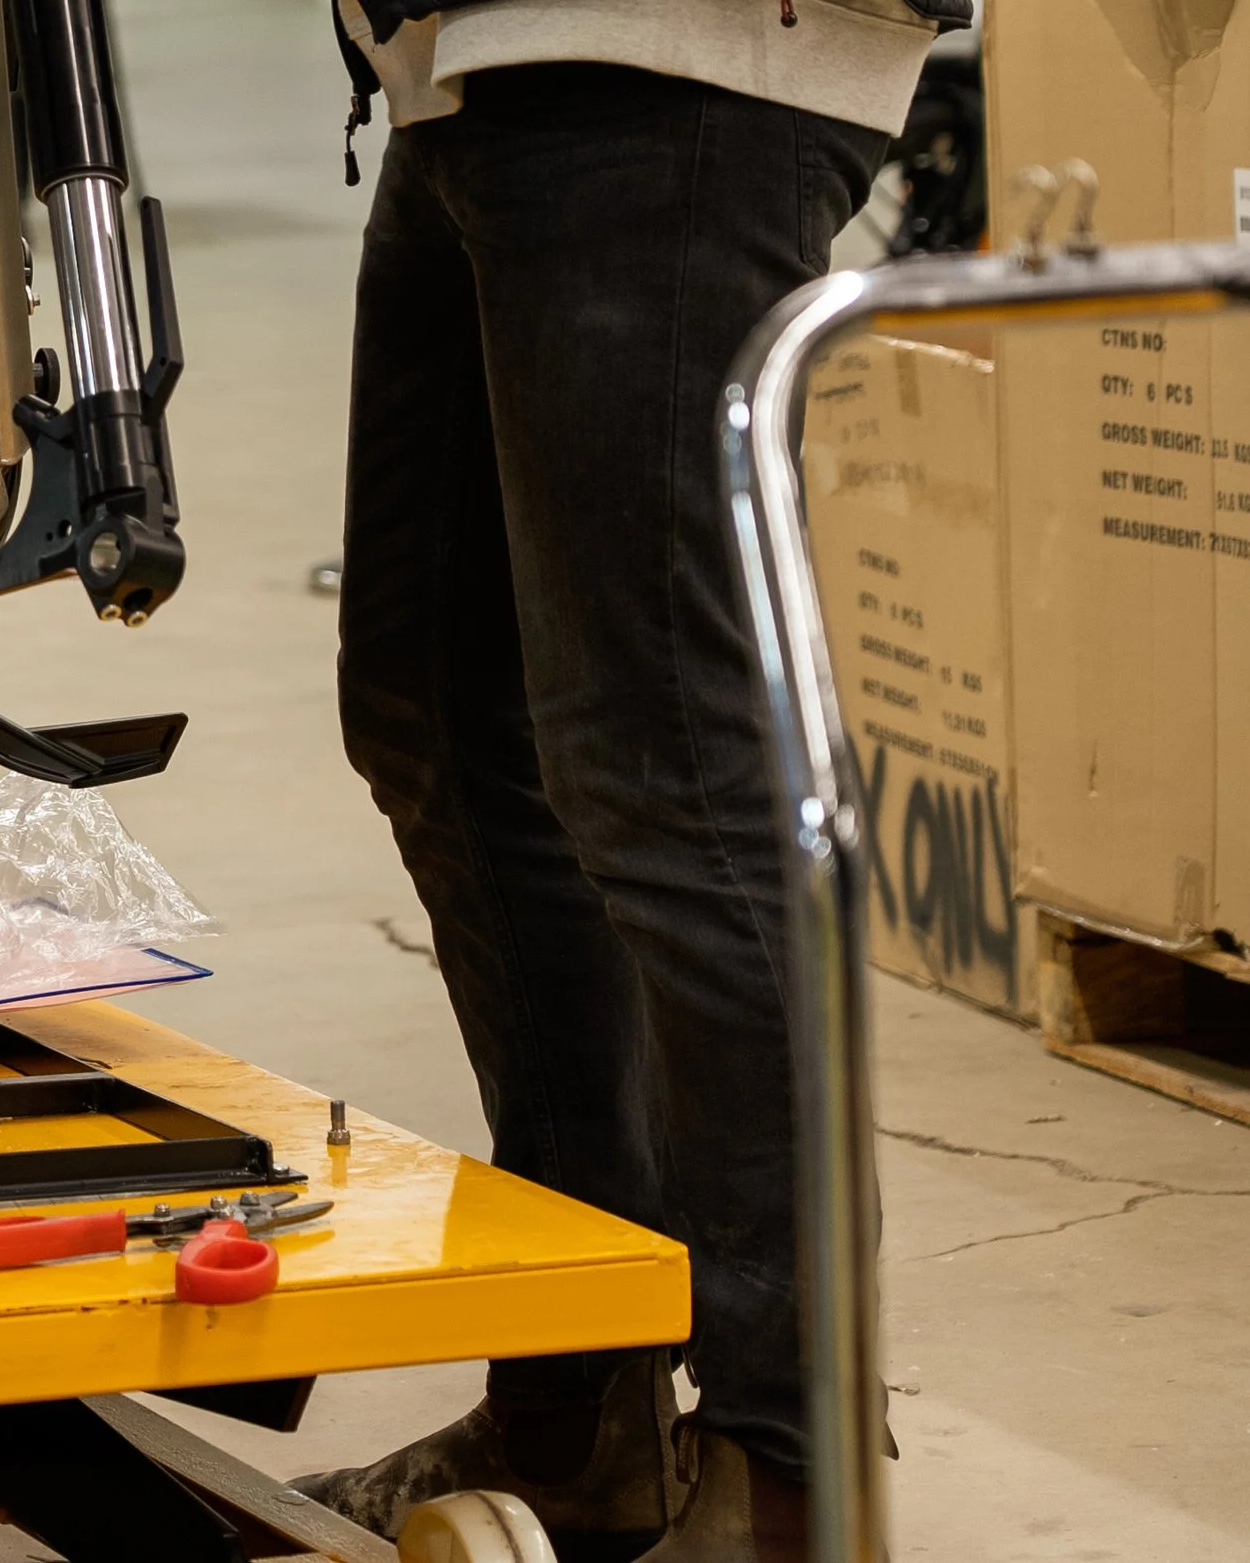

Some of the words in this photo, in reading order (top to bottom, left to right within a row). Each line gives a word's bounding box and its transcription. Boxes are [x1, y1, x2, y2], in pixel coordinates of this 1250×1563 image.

[1101, 328, 1138, 350] CTNS
[1101, 421, 1148, 446] GROSS
[1151, 427, 1206, 455] WEIGHT:
[1102, 469, 1128, 491] NET
[1131, 472, 1188, 501] WEIGHT:
[1103, 515, 1206, 551] MEASUREMENT:
